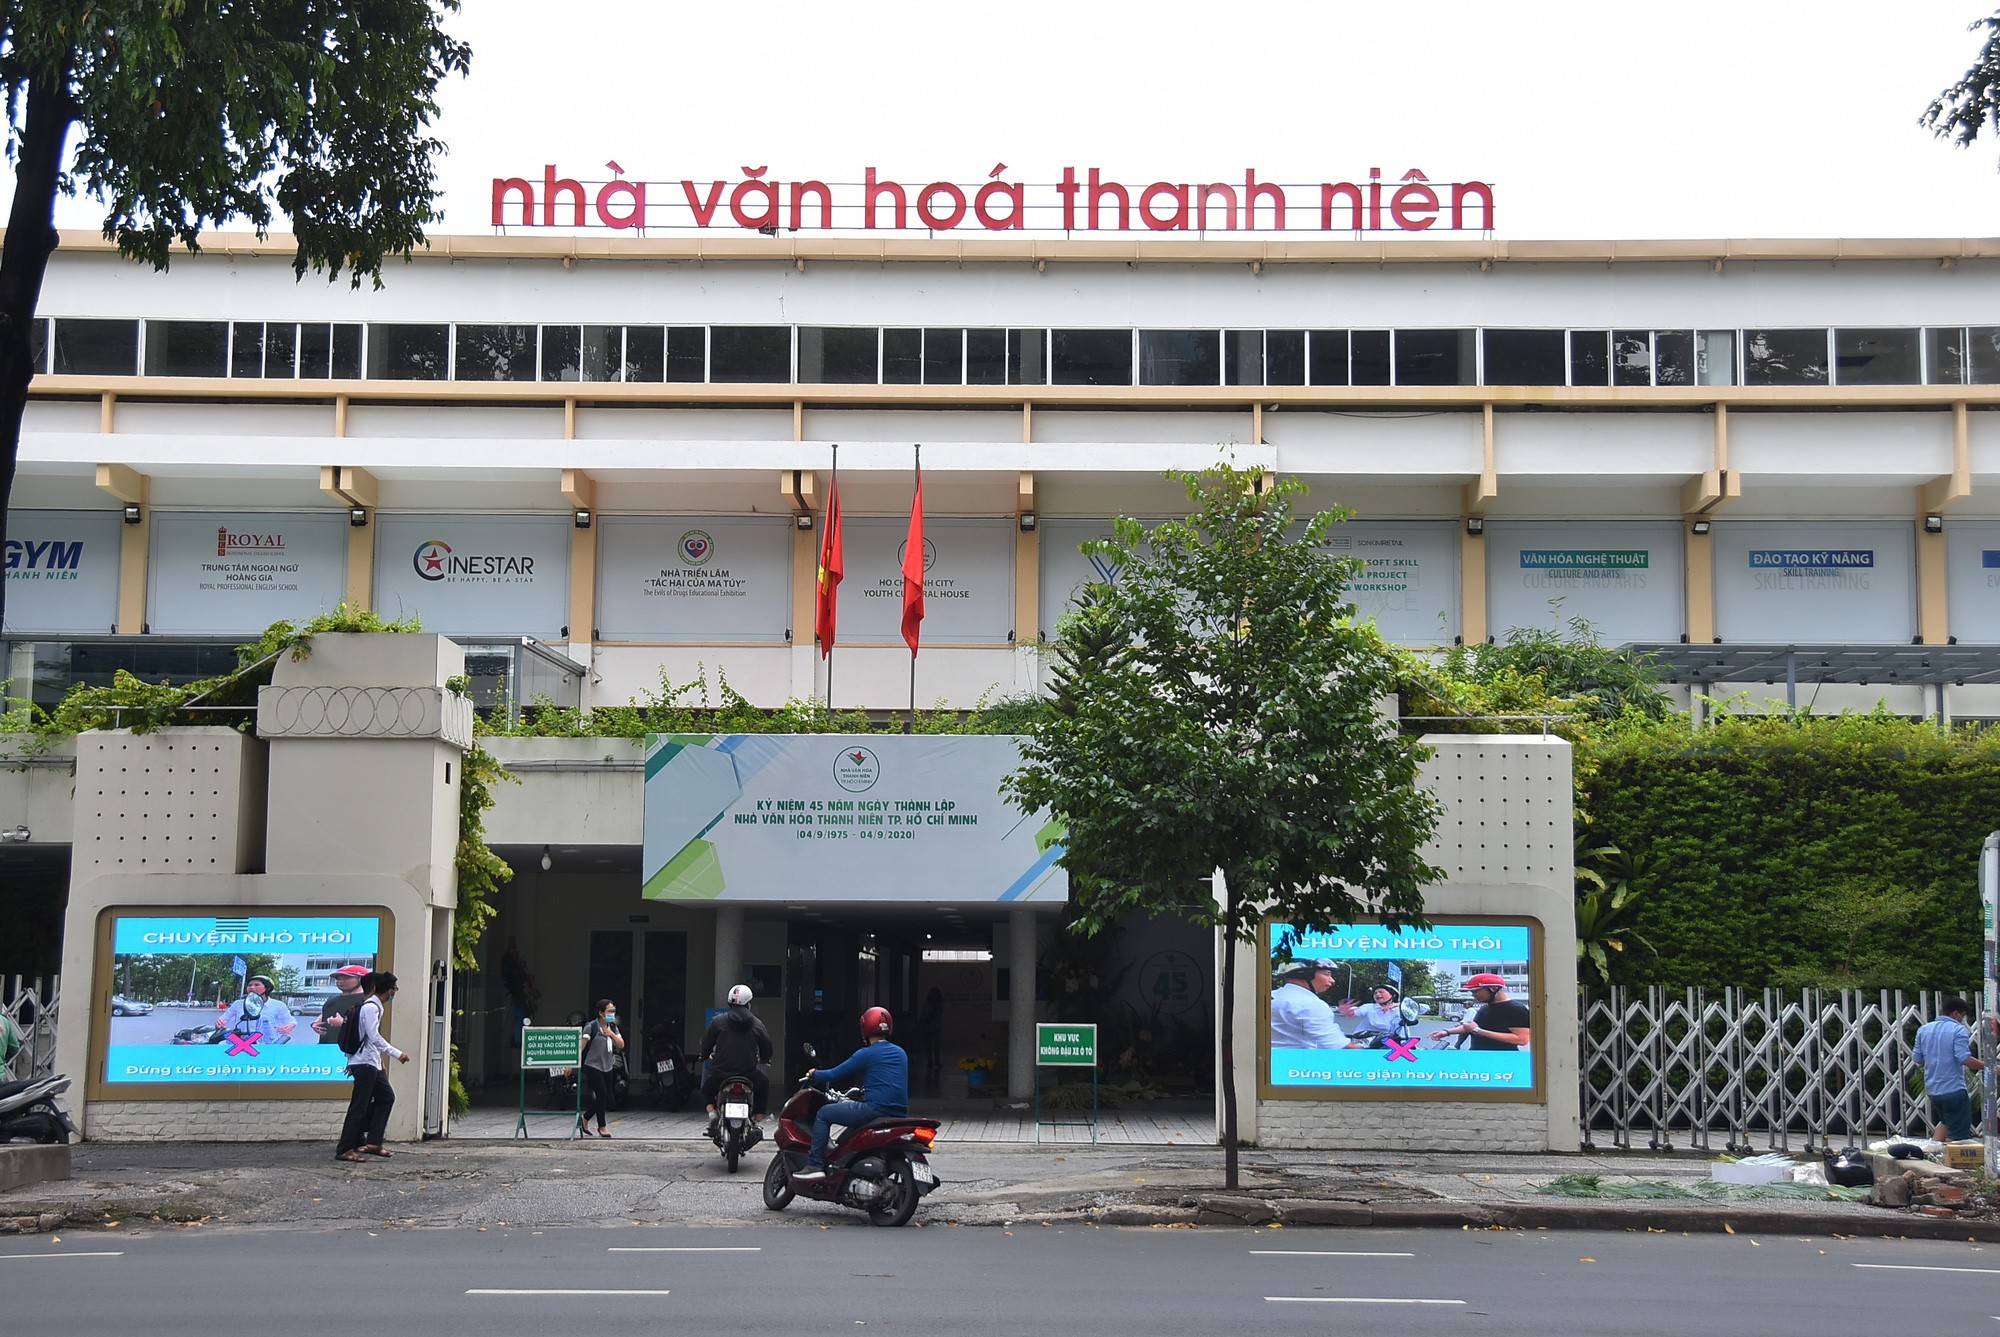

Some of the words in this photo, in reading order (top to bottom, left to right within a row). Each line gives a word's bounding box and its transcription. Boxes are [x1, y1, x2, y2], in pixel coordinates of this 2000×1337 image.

[492, 160, 646, 230] nhà
[681, 166, 832, 230] văn
[865, 162, 1024, 231] hoá
[1056, 166, 1286, 231] thanh
[1321, 167, 1494, 231] niên
[227, 534, 286, 546] ROYAL
[5, 540, 84, 569] GYM
[1523, 553, 1549, 564] VĂN
[1549, 552, 1574, 564] HÓA
[1576, 553, 1607, 567] NGHỆ
[1609, 552, 1646, 567] THUẬT
[1753, 552, 1781, 564] ĐÀO
[1784, 554, 1809, 567] TẠO
[1812, 552, 1829, 564] KỸ
[1831, 551, 1869, 564] NĂNG
[413, 540, 534, 581] CINESTAR
[1366, 559, 1390, 567] SOFT
[1393, 559, 1419, 567] SKILL
[201, 564, 230, 572] TRUNG
[232, 563, 249, 572] TÂM
[251, 564, 278, 574] NGOẠI
[280, 563, 299, 572] NGỮ
[660, 568, 680, 577] NHÀ
[682, 567, 708, 578] TRIỂN
[1548, 569, 1581, 578] CULTURE
[1583, 569, 1600, 578] AND
[1601, 569, 1620, 578] ARTS
[1783, 568, 1803, 577] SKILL
[1805, 568, 1840, 577] TRAINING
[4, 571, 40, 579] HANH
[46, 570, 78, 579] NIÊN
[226, 573, 256, 581] HOÀNG
[1367, 571, 1408, 579] PROJECT
[669, 580, 685, 589] HẠI
[687, 578, 705, 587] CỦA
[879, 579, 892, 587] HO
[894, 579, 905, 587] CH
[673, 589, 688, 597] Drugs
[689, 589, 719, 597] Educational
[720, 589, 746, 597] Exhibition
[863, 589, 893, 598] YOUTH
[894, 590, 938, 598] CURAL
[940, 590, 970, 598] HOUSE
[757, 797, 772, 811] KỶ
[777, 798, 805, 813] NIỆM
[809, 801, 823, 811] 45
[828, 799, 853, 811] NĂM
[858, 799, 889, 811] NGÀY
[894, 799, 930, 811] THÀNH
[734, 812, 757, 824] NHÀ
[762, 812, 785, 824] VĂN
[789, 812, 813, 825] HÓA
[817, 814, 853, 825] THANH
[858, 813, 883, 825] NIÊN
[888, 815, 902, 825] TP.
[926, 812, 944, 825] CHÍ
[948, 815, 977, 825] MINH
[143, 930, 236, 947] CHUYỆN
[243, 929, 293, 944] NHỎ
[298, 930, 352, 944] THÔI
[1299, 935, 1387, 951] CHUYỆN
[1394, 935, 1444, 949] NHỎ
[1448, 936, 1501, 949] THÔI
[1053, 1033, 1067, 1042] KHU
[1067, 1033, 1080, 1043] VỰC
[1040, 1045, 1059, 1055] KHÔNG
[1072, 1046, 1079, 1055] XE
[126, 1064, 172, 1076] Đừng
[175, 1064, 203, 1075] tức
[206, 1065, 242, 1077] giận
[246, 1064, 277, 1076] hay
[280, 1064, 333, 1076] hoảng
[1288, 1069, 1333, 1081] Đừng
[1336, 1069, 1363, 1079] tức
[1366, 1070, 1402, 1081] giận
[1406, 1070, 1435, 1081] hay
[1439, 1069, 1491, 1082] hoảng
[1494, 1071, 1514, 1082] sợ
